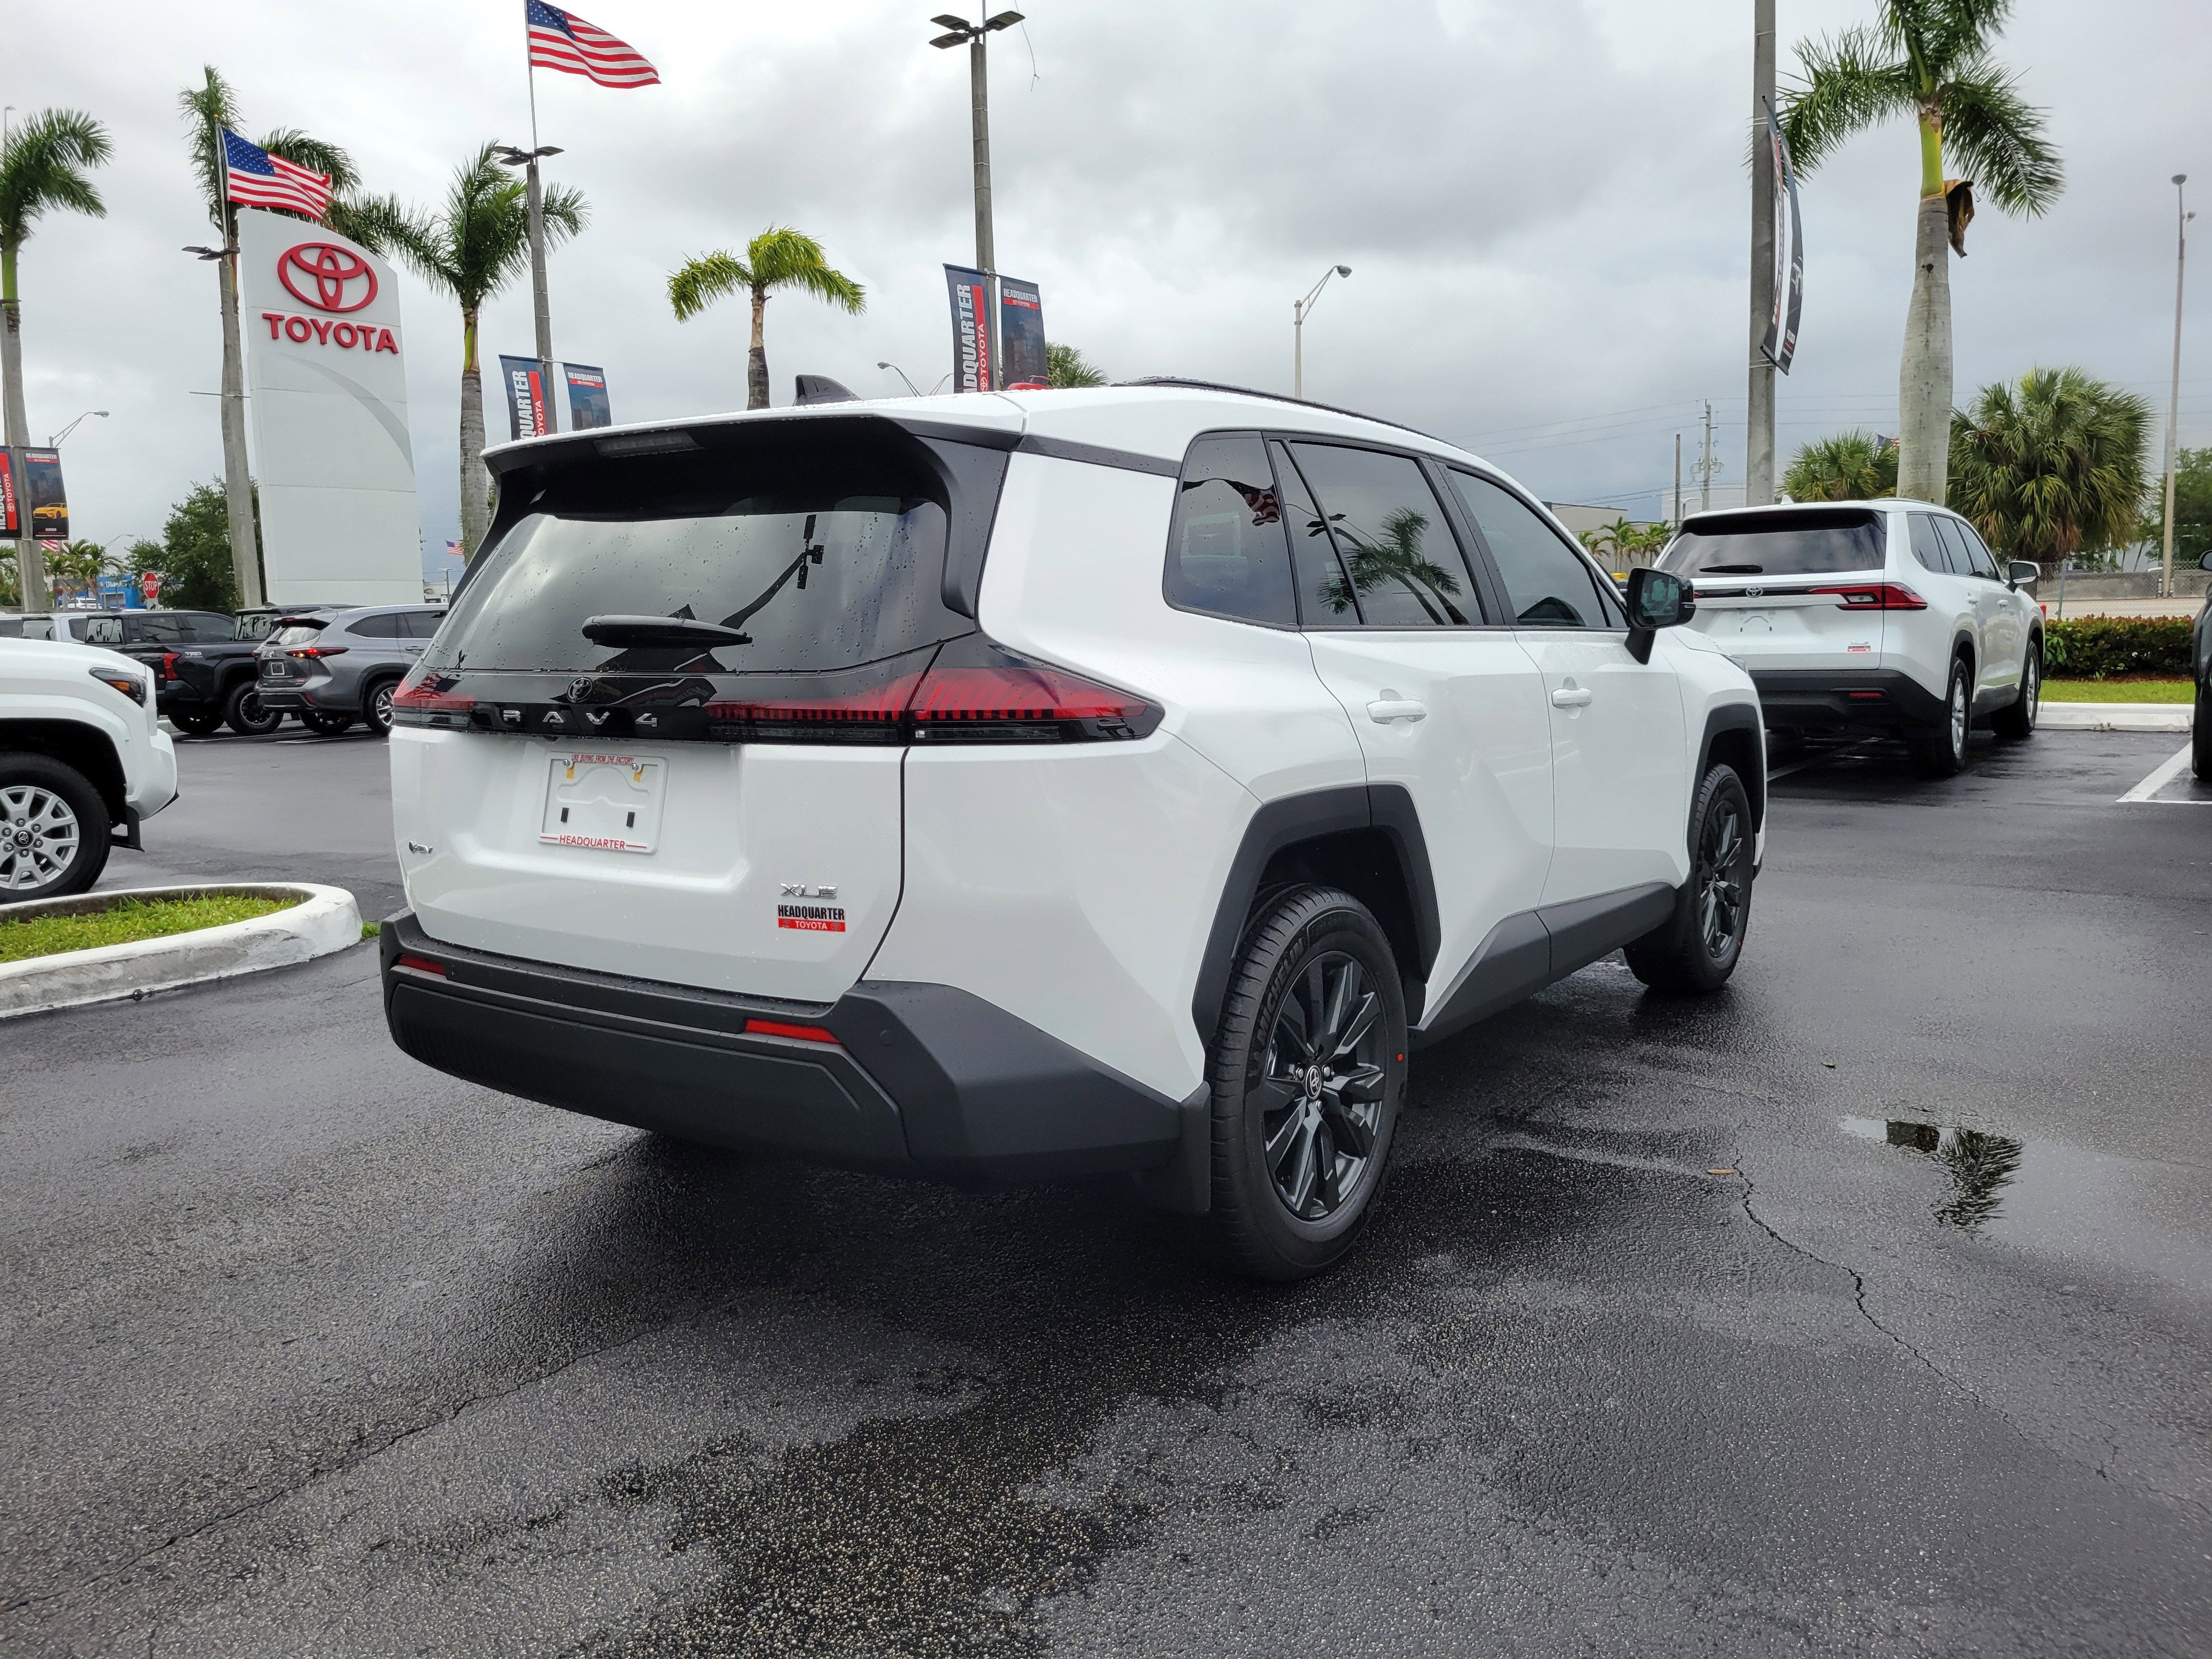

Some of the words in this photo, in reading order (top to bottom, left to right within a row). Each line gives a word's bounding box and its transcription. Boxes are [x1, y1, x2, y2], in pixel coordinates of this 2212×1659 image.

[1003, 287, 1039, 303] HEADQUARTER
[262, 313, 399, 354] TOYOTA
[957, 284, 979, 393] DQUARTER
[978, 323, 987, 376] TOYOTA
[535, 400, 545, 436] OYOTA
[4, 473, 13, 502] TOYOTA
[144, 580, 157, 591] STOP
[503, 709, 658, 727] RAV4
[559, 834, 625, 849] HEADQUARTER
[780, 883, 837, 899] XLE
[777, 904, 845, 921] HEADQUARTER
[795, 921, 827, 930] TOYOTA
[1257, 937, 1304, 1048] MICHELIN
